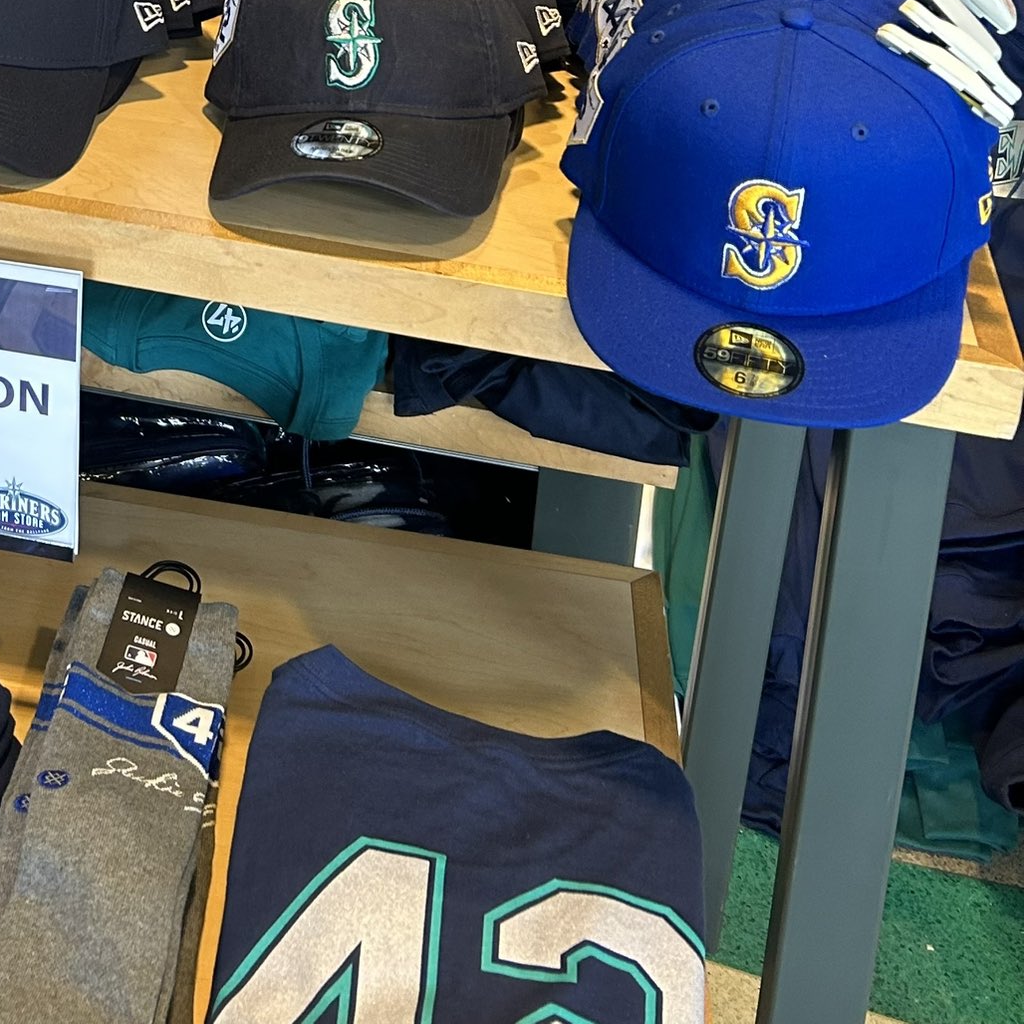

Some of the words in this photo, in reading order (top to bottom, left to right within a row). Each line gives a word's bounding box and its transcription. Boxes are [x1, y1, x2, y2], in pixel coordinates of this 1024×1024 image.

[14, 512, 44, 529] STORE
[122, 610, 164, 632] STANCE
[133, 635, 157, 649] CASUAL
